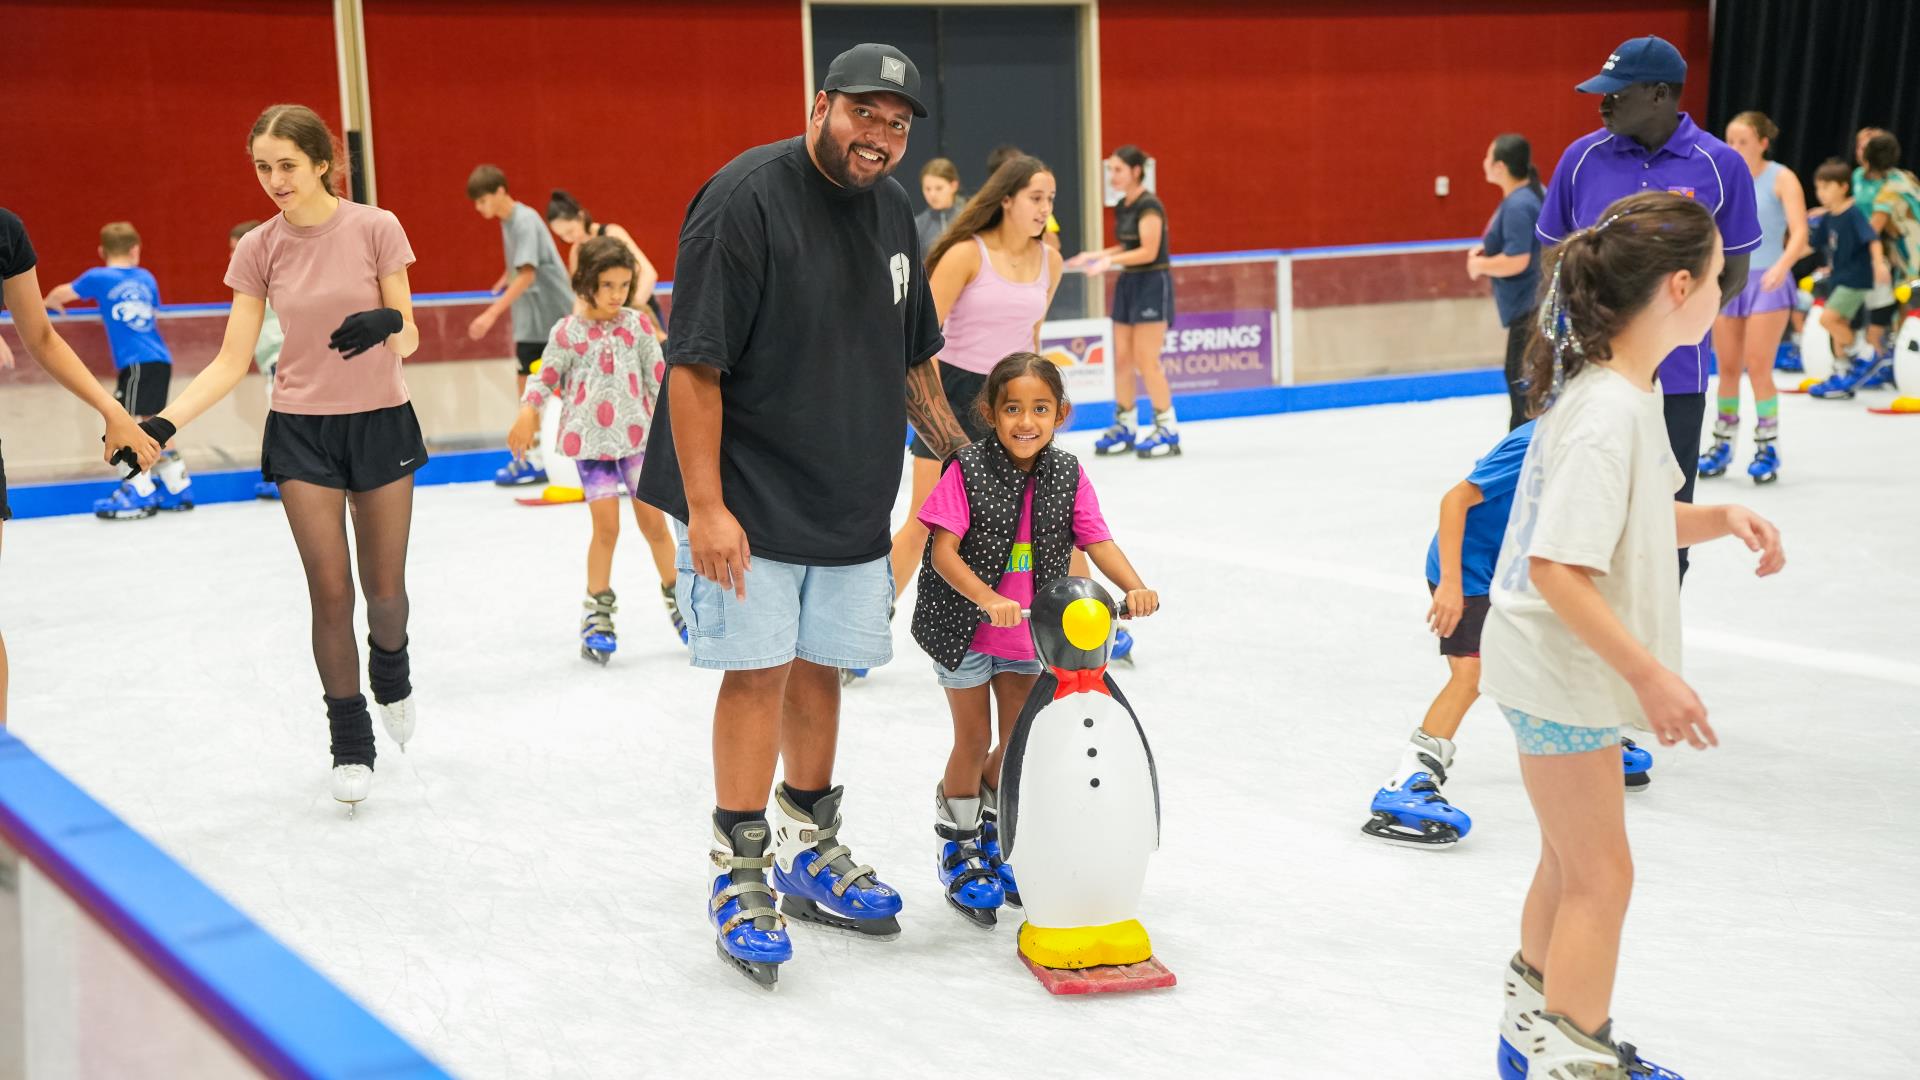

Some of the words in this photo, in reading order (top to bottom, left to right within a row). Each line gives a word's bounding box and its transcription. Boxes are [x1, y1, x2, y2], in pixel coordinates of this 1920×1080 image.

[1160, 330, 1178, 353] E
[1180, 325, 1262, 352] SPRINGS
[1184, 351, 1263, 375] COUNCIL
